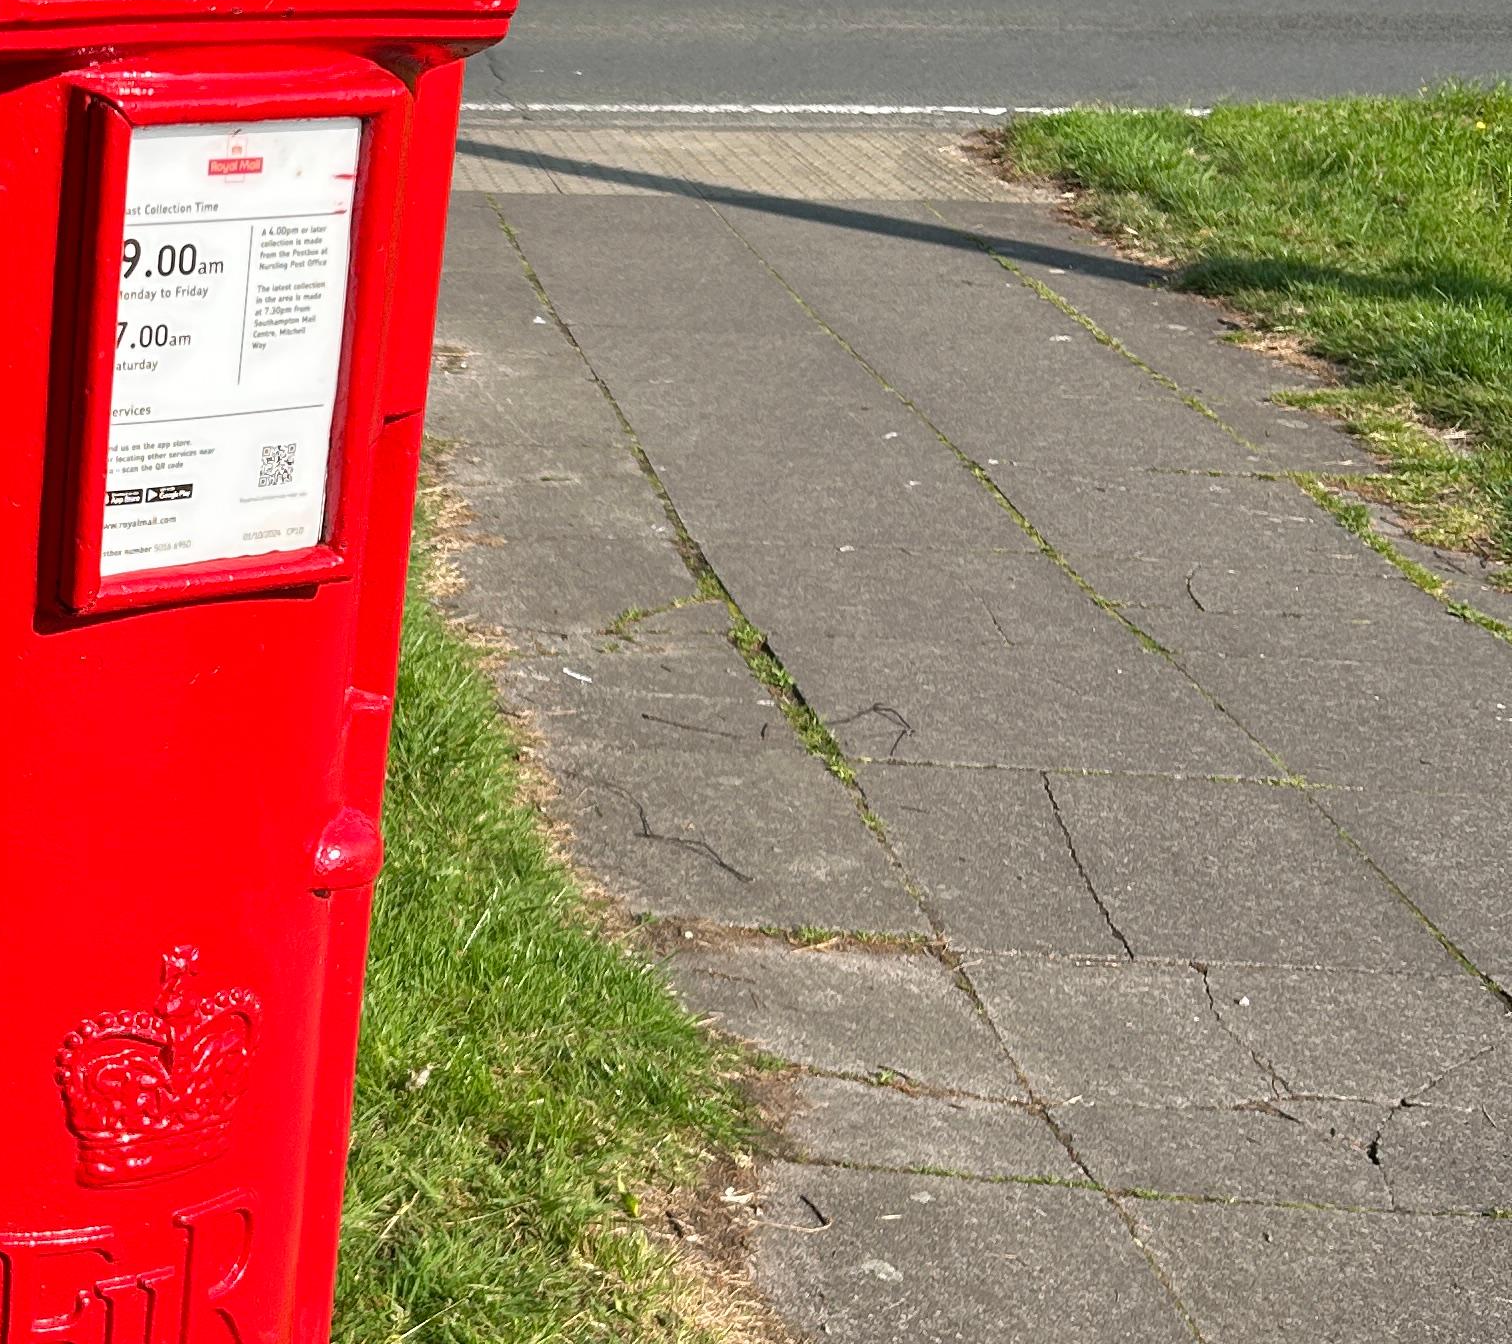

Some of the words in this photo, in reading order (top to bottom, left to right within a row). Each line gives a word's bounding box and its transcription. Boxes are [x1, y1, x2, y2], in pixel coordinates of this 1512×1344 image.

[210, 159, 238, 174] Royal
[239, 158, 261, 171] Mail
[125, 207, 141, 215] ast
[144, 202, 192, 215] Collection
[195, 201, 219, 213] Time
[160, 287, 171, 298] to
[176, 285, 209, 298] Friday
[252, 342, 266, 350] Way
[116, 359, 159, 372] aturday
[112, 404, 151, 417] ervices
